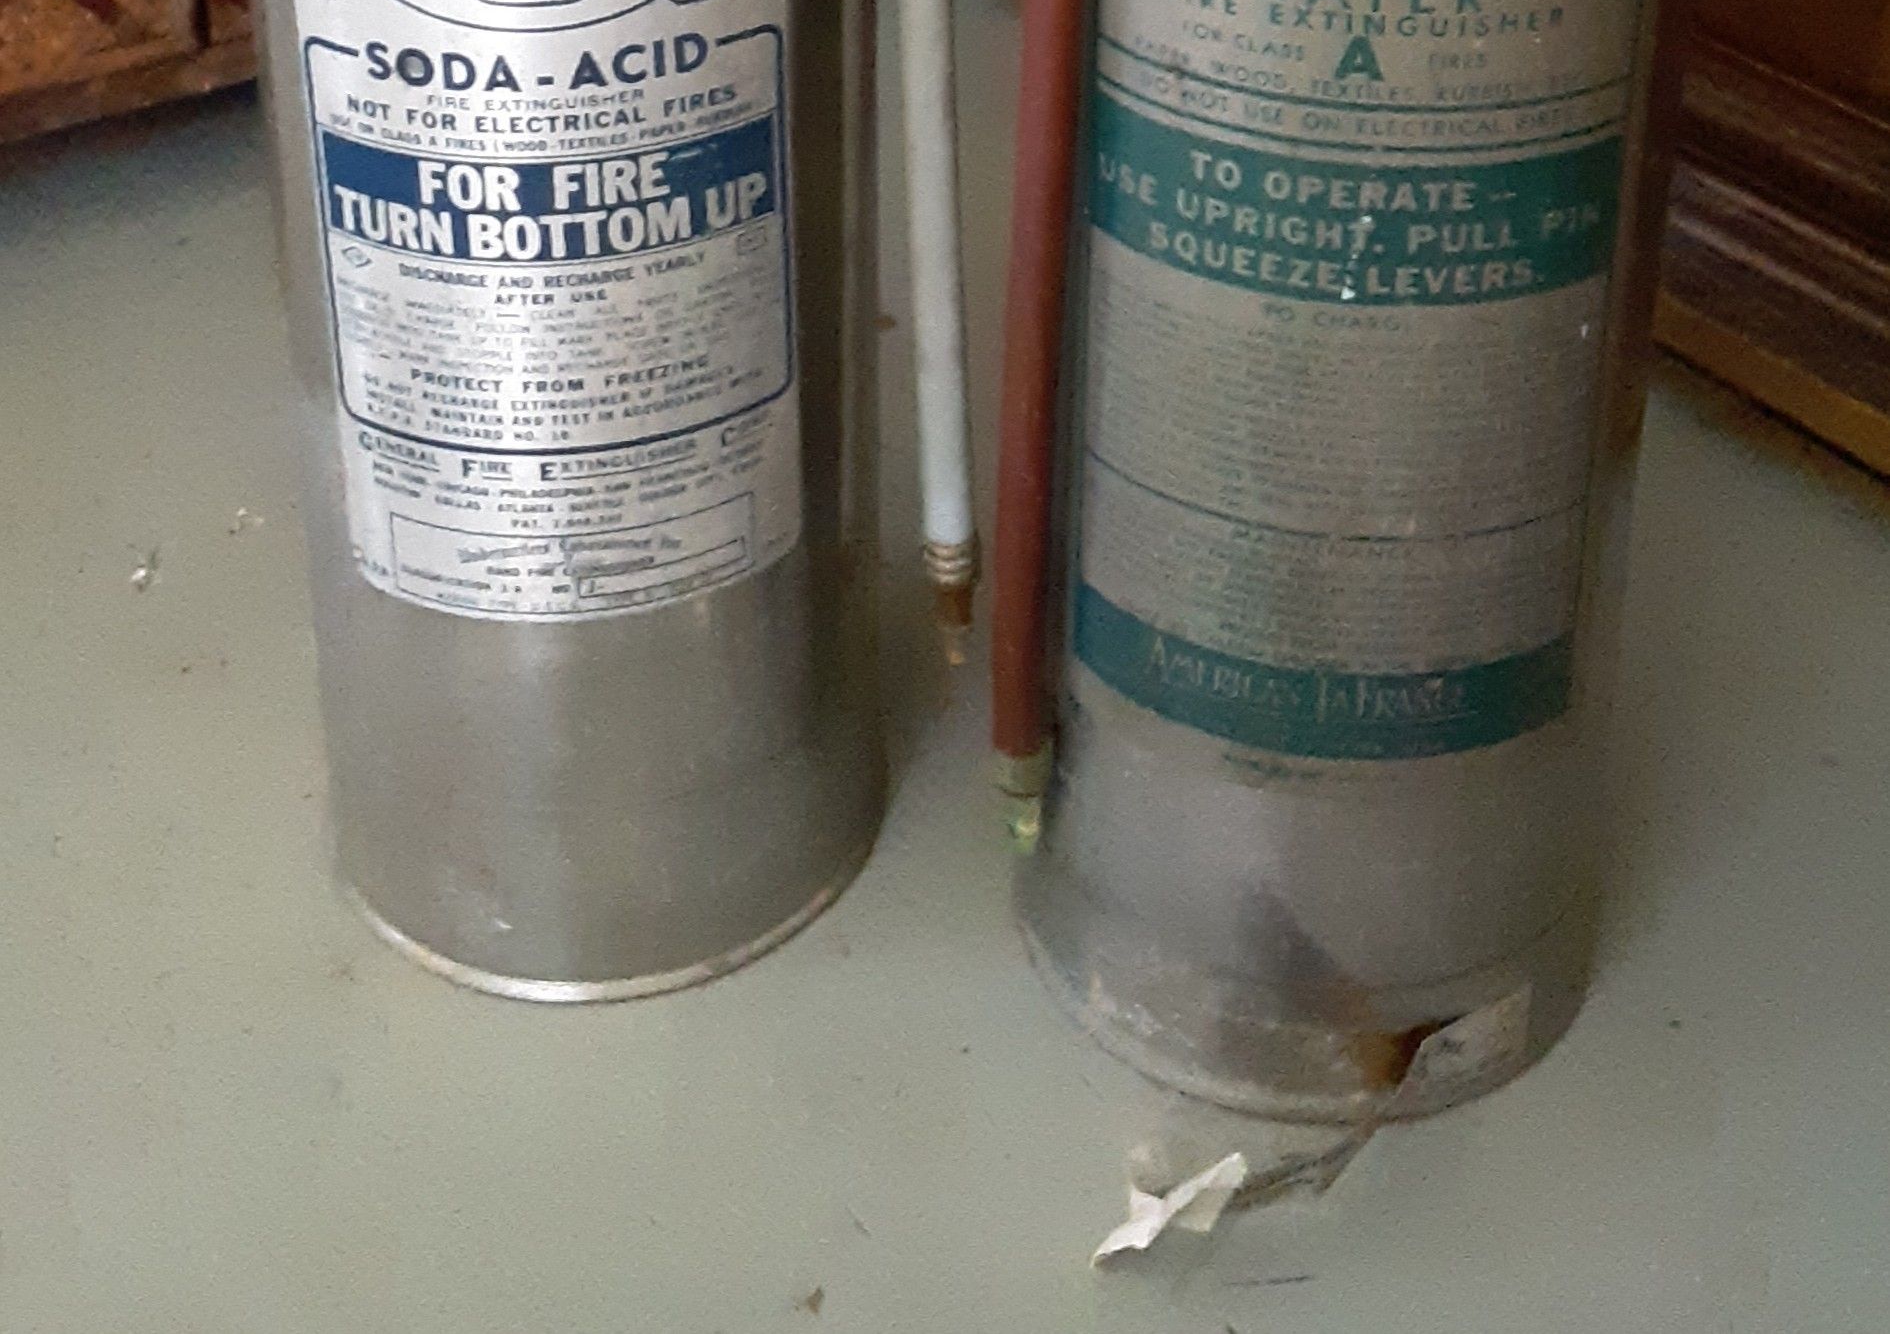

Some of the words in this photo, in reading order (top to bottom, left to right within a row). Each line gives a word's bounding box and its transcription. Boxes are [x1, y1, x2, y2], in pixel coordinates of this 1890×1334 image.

[1269, 4, 1564, 38] EXTINGUISHER
[1333, 34, 1386, 82] A
[346, 93, 391, 121] NOT
[406, 108, 457, 132] FOR
[475, 105, 647, 134] ELECTRICAL
[662, 83, 737, 118] FIRES
[426, 94, 471, 112] FIRE
[485, 88, 645, 114] EXTINGUISHER
[1302, 110, 1341, 132] ON
[1355, 114, 1506, 139] ELECTRICAL
[416, 159, 522, 212] FOR
[551, 150, 673, 210] FIRE
[1099, 151, 1158, 207] USE
[1406, 220, 1520, 255] PULL
[1190, 150, 1242, 191] TO
[1264, 170, 1477, 212] OPERATE
[333, 184, 456, 257] TURN
[466, 196, 693, 261] BOTTOM
[705, 171, 768, 229] UP
[1149, 220, 1344, 292] SQUEEZE
[494, 293, 556, 306] AFTER
[570, 288, 608, 303] USE
[496, 274, 534, 289] AND
[410, 367, 504, 393] PROTECT
[522, 378, 584, 394] FROM
[604, 350, 709, 388] FREEZING
[461, 458, 514, 478] FIRE
